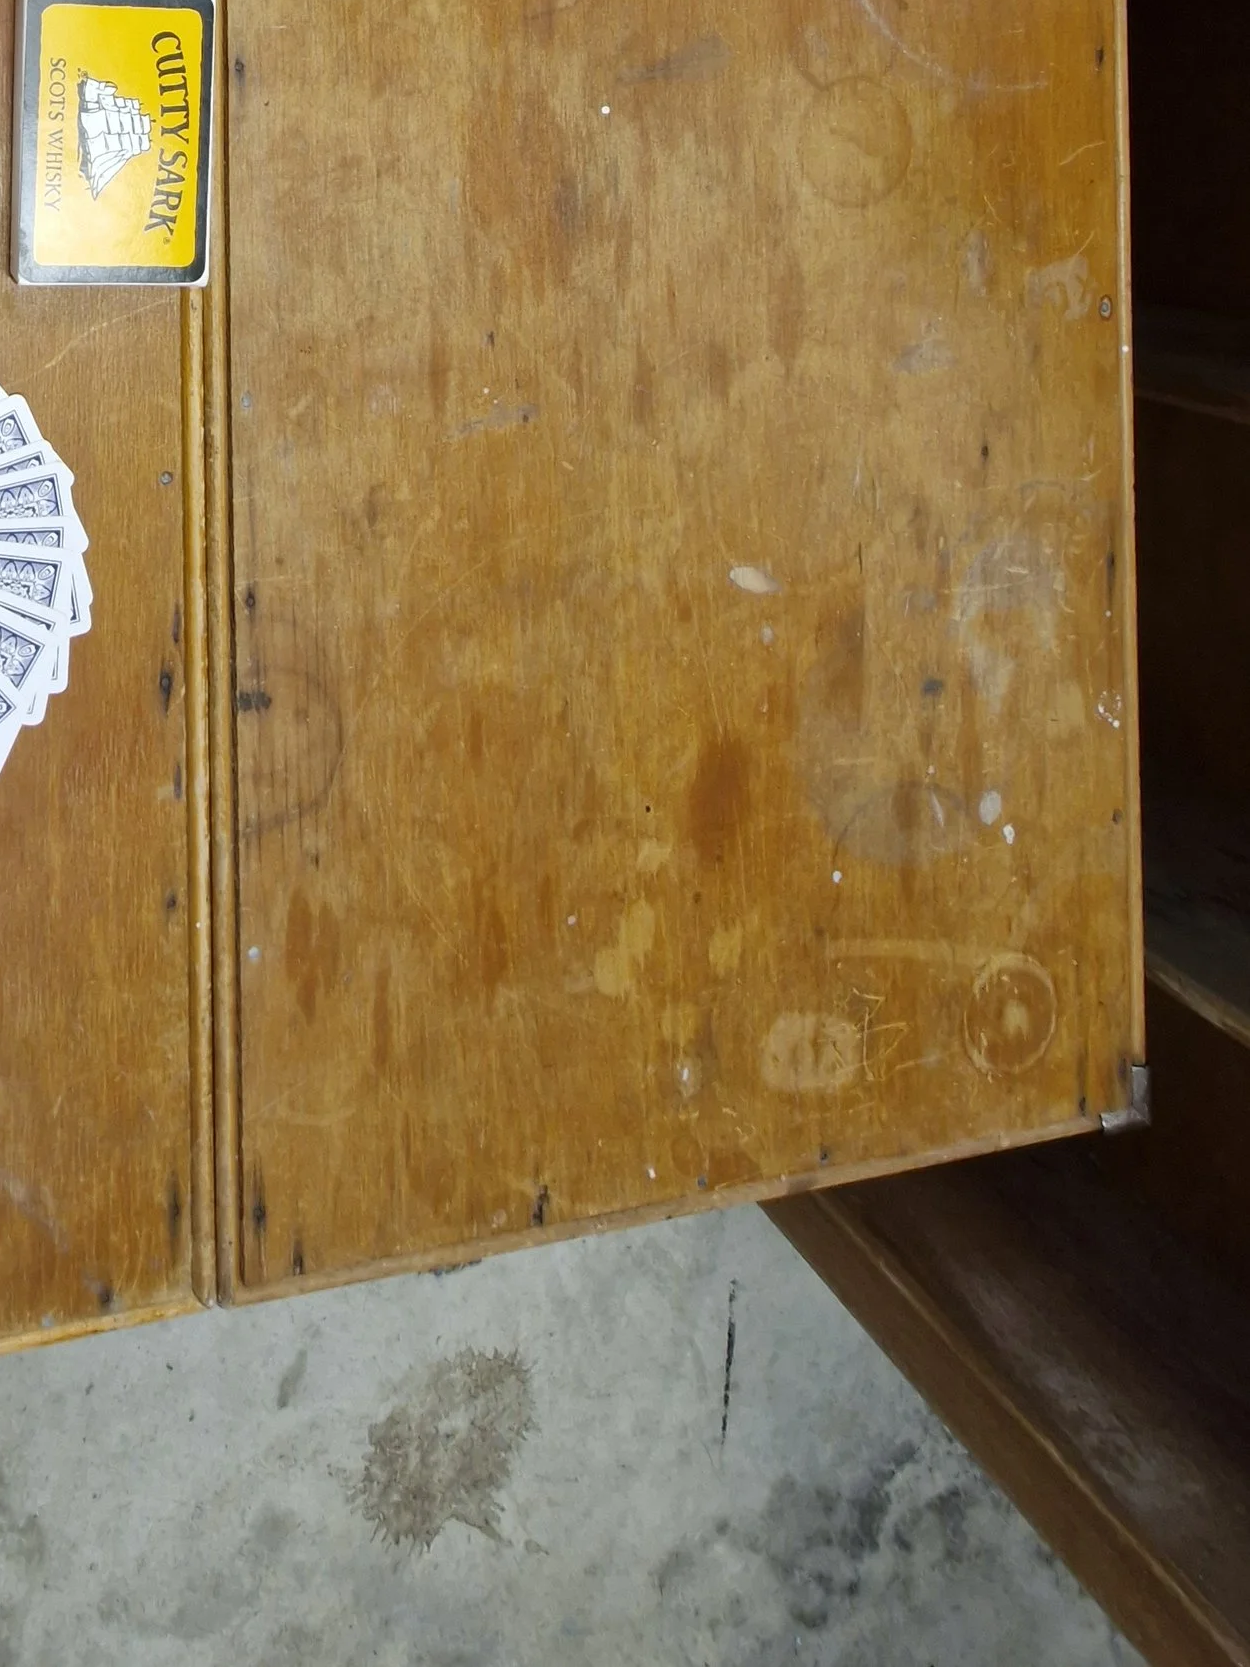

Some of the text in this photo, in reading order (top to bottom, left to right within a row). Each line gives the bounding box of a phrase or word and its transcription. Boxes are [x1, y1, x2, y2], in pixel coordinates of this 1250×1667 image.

[43, 57, 66, 211] SCOTS WHISKY
[145, 31, 189, 238] CUTTY SARK
